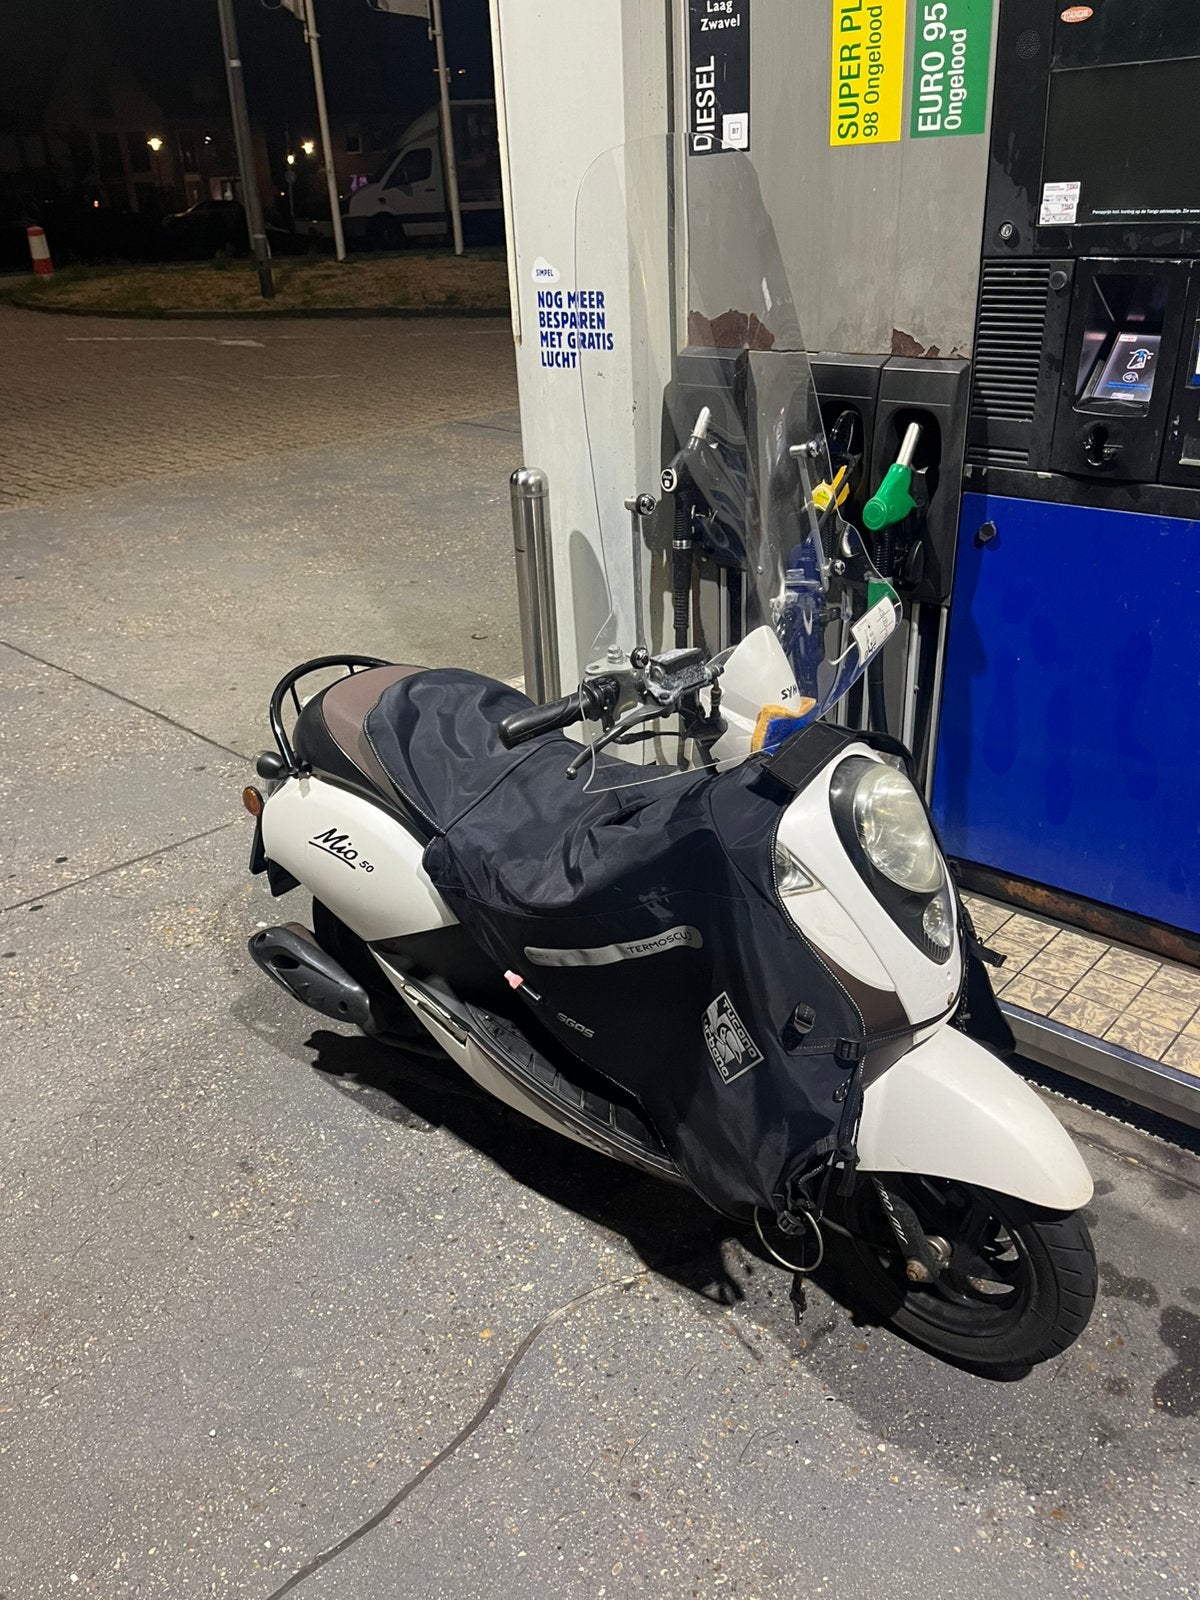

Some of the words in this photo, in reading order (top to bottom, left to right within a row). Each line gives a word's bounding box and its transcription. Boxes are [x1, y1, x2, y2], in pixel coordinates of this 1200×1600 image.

[706, 0, 733, 13] Laag
[700, 14, 740, 31] Zwavel
[923, 2, 948, 42] 95
[863, 5, 884, 104] Ongelood
[837, 43, 861, 139] SUPER
[917, 51, 945, 132] EURO
[943, 28, 967, 130] Ongelood
[693, 55, 715, 151] DIESEL
[863, 111, 879, 137] 98
[535, 268, 554, 277] SIMPEL
[537, 291, 563, 309] NOG
[567, 291, 605, 309] MEER
[538, 311, 606, 329] BESPAREN
[540, 331, 562, 348] MET
[567, 332, 614, 351] GRATIS
[541, 351, 577, 369] LUCHT
[313, 828, 358, 860] Mio
[359, 860, 375, 873] 50
